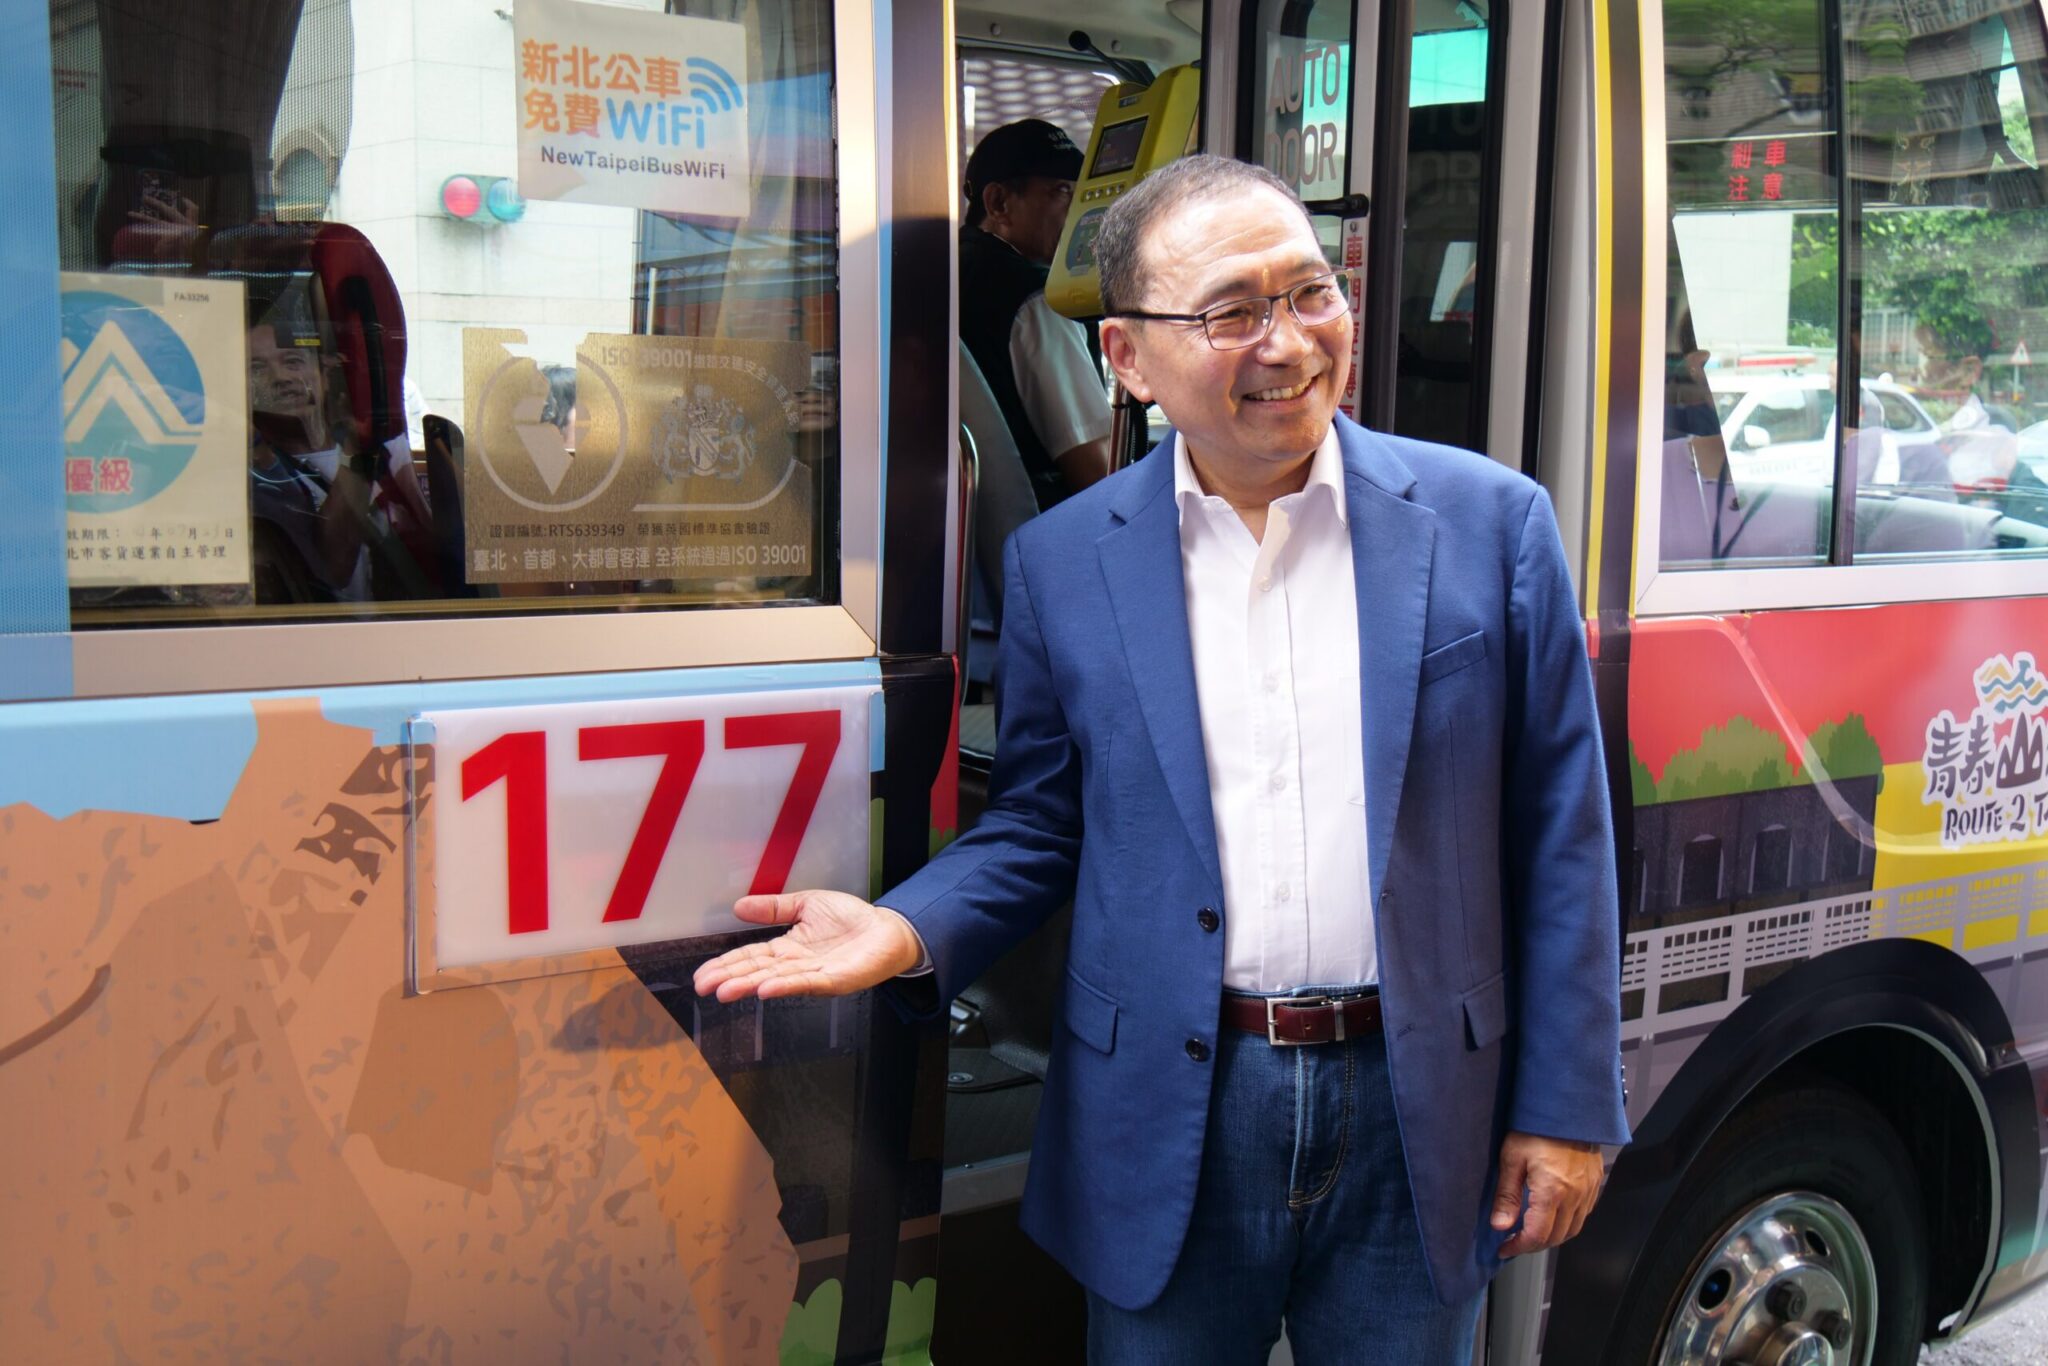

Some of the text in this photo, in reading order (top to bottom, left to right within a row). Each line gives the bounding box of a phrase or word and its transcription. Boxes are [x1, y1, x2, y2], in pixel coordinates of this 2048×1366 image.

[522, 39, 682, 98] 新北公車
[1266, 43, 1341, 117] AUTO
[541, 146, 726, 179] NewTaipeiBusWiFi
[65, 459, 132, 493] 優級
[762, 545, 807, 565] 39001
[1928, 711, 2048, 798] 青春山
[461, 709, 841, 935] 177
[1945, 801, 2002, 841] ROUTE
[2010, 794, 2026, 832] 2
